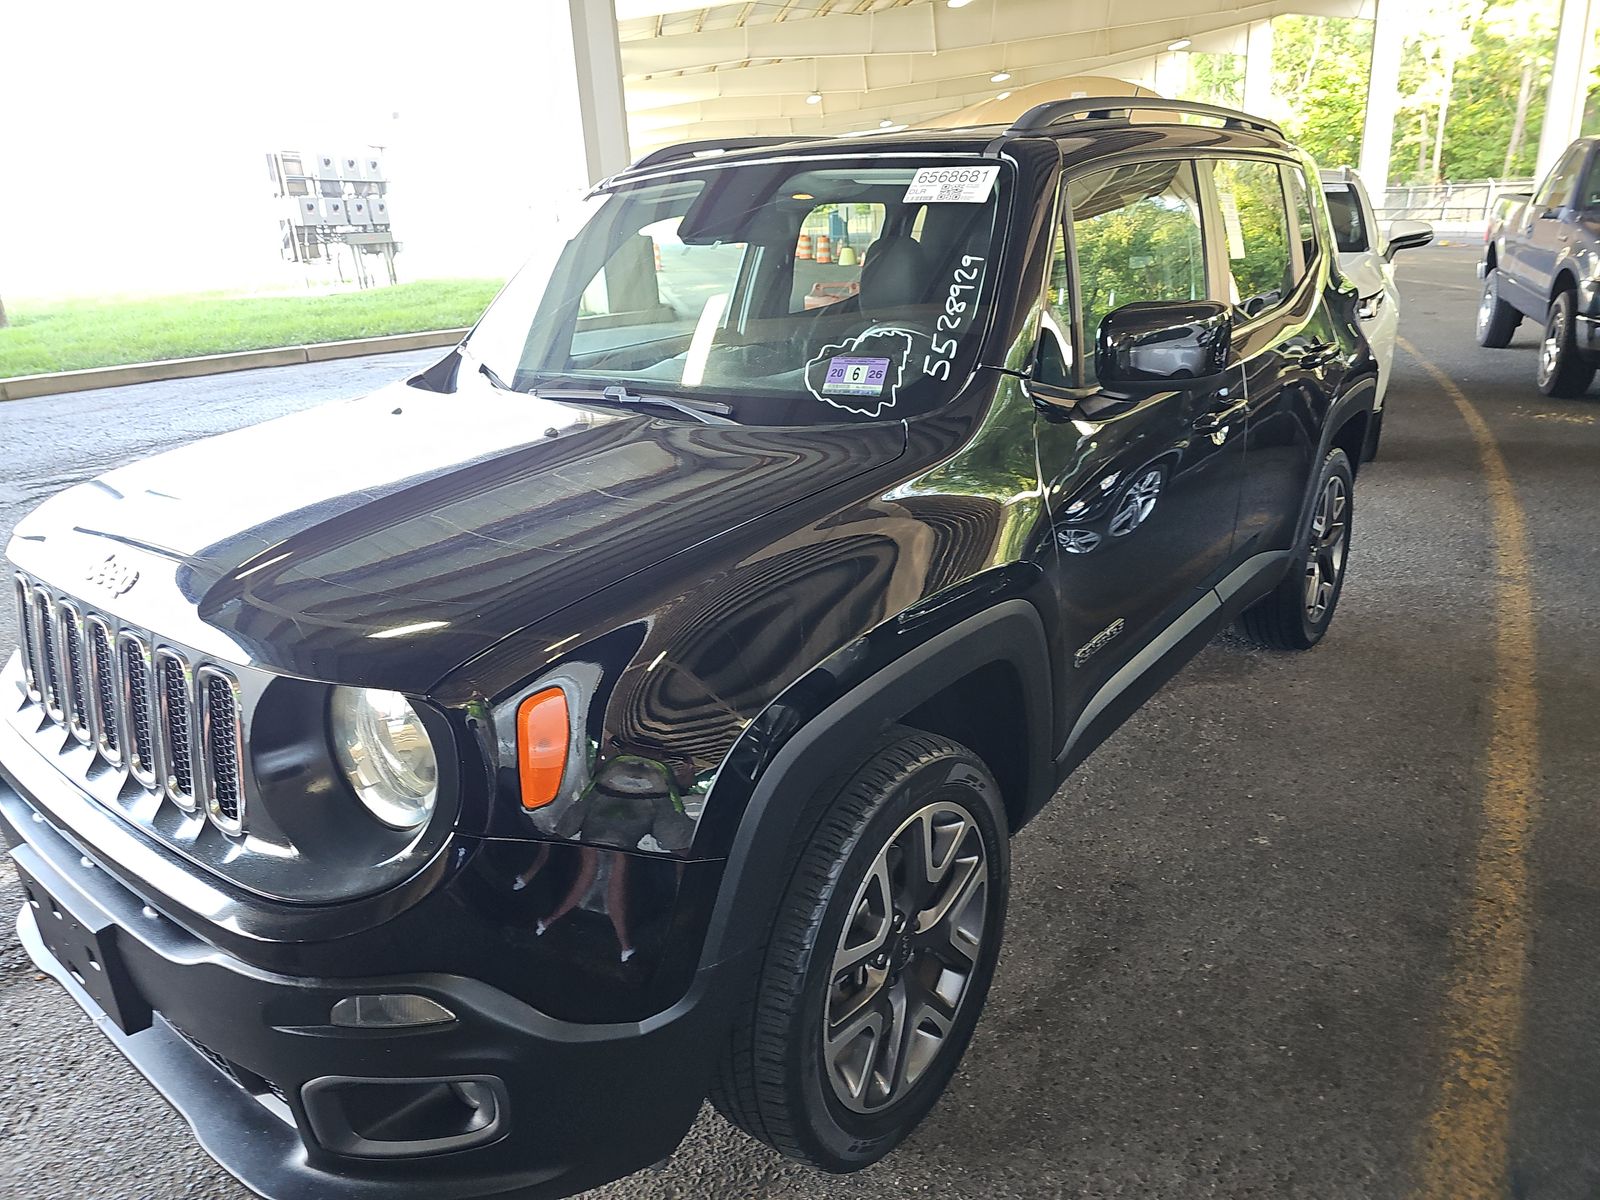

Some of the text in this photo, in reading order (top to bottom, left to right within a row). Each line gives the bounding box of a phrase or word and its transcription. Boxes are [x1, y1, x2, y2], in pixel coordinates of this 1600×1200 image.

[918, 169, 990, 184] 6568681
[922, 254, 985, 381] 5528929
[830, 367, 883, 381] 20 6 26
